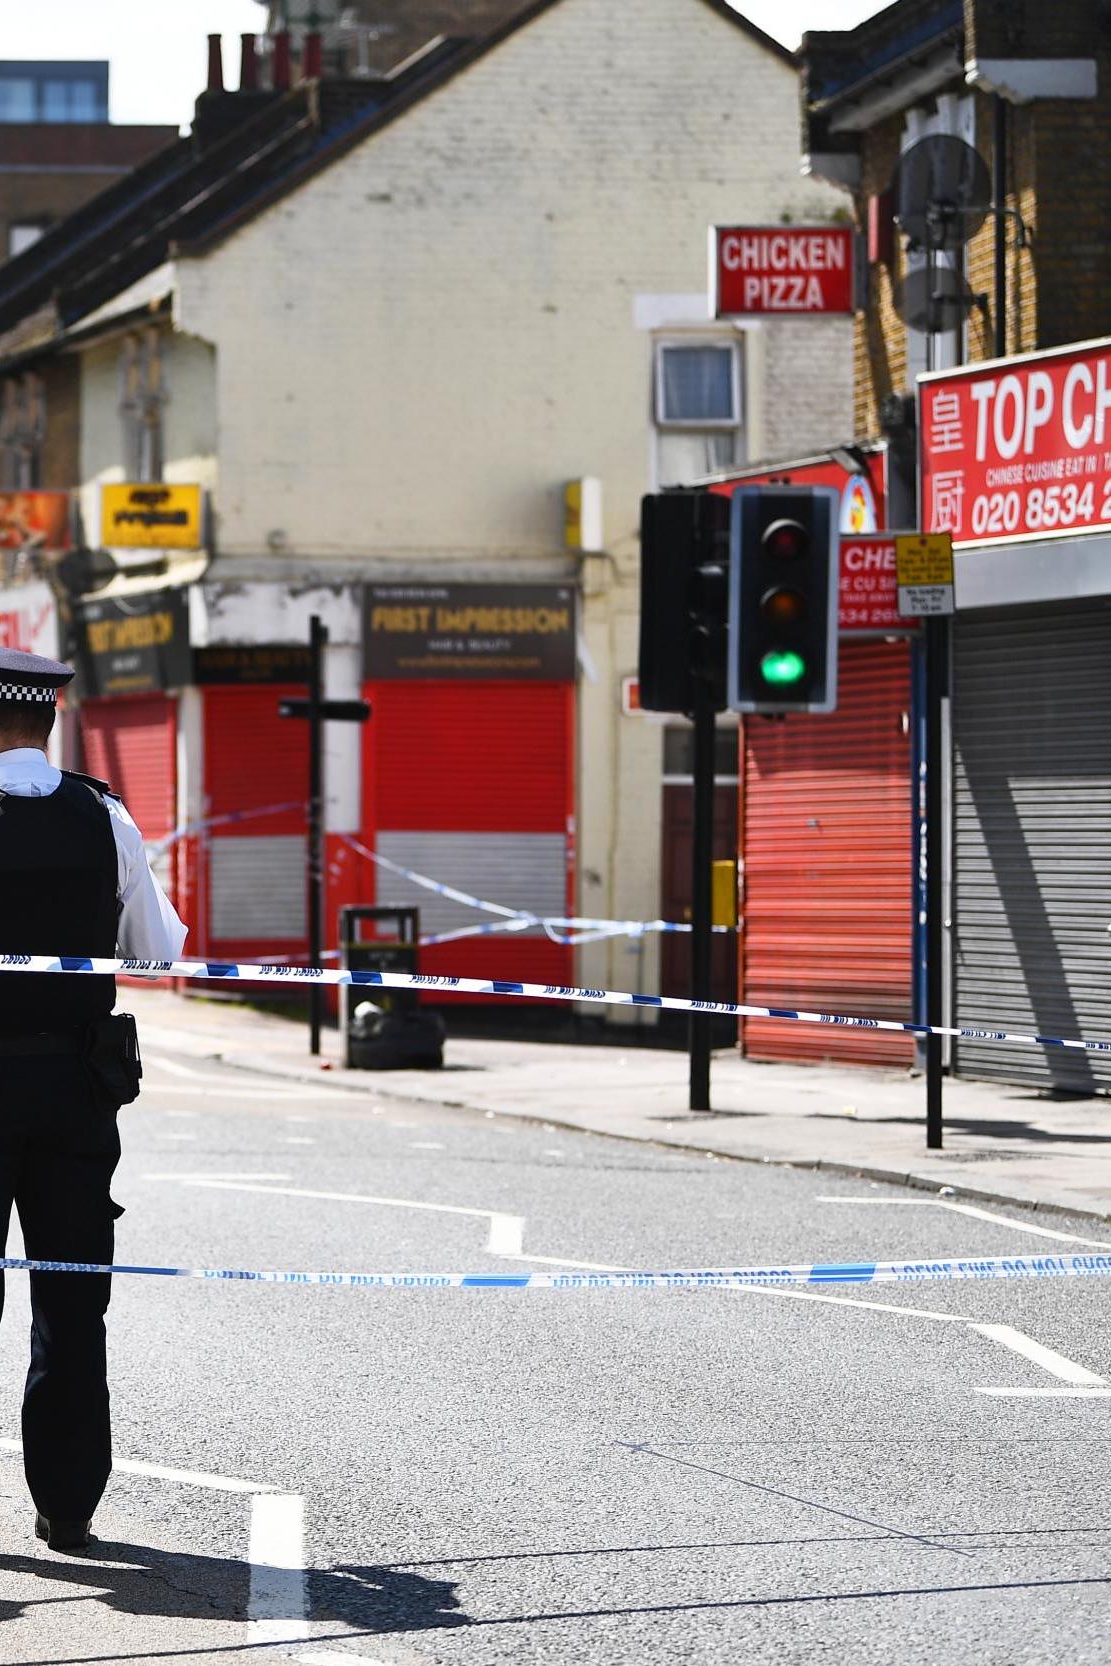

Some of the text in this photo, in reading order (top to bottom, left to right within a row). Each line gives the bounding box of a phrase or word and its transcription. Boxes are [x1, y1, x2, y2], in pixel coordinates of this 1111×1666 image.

[723, 236, 845, 270] CHICKEN
[744, 276, 824, 309] PIZZA
[971, 371, 1054, 462] TOP
[986, 466, 1024, 487] CHINESE
[1025, 462, 1064, 483] CUISINE
[971, 490, 1020, 535] 020
[1025, 481, 1095, 529] 8534
[371, 607, 569, 633] FIRST IMPRESSION
